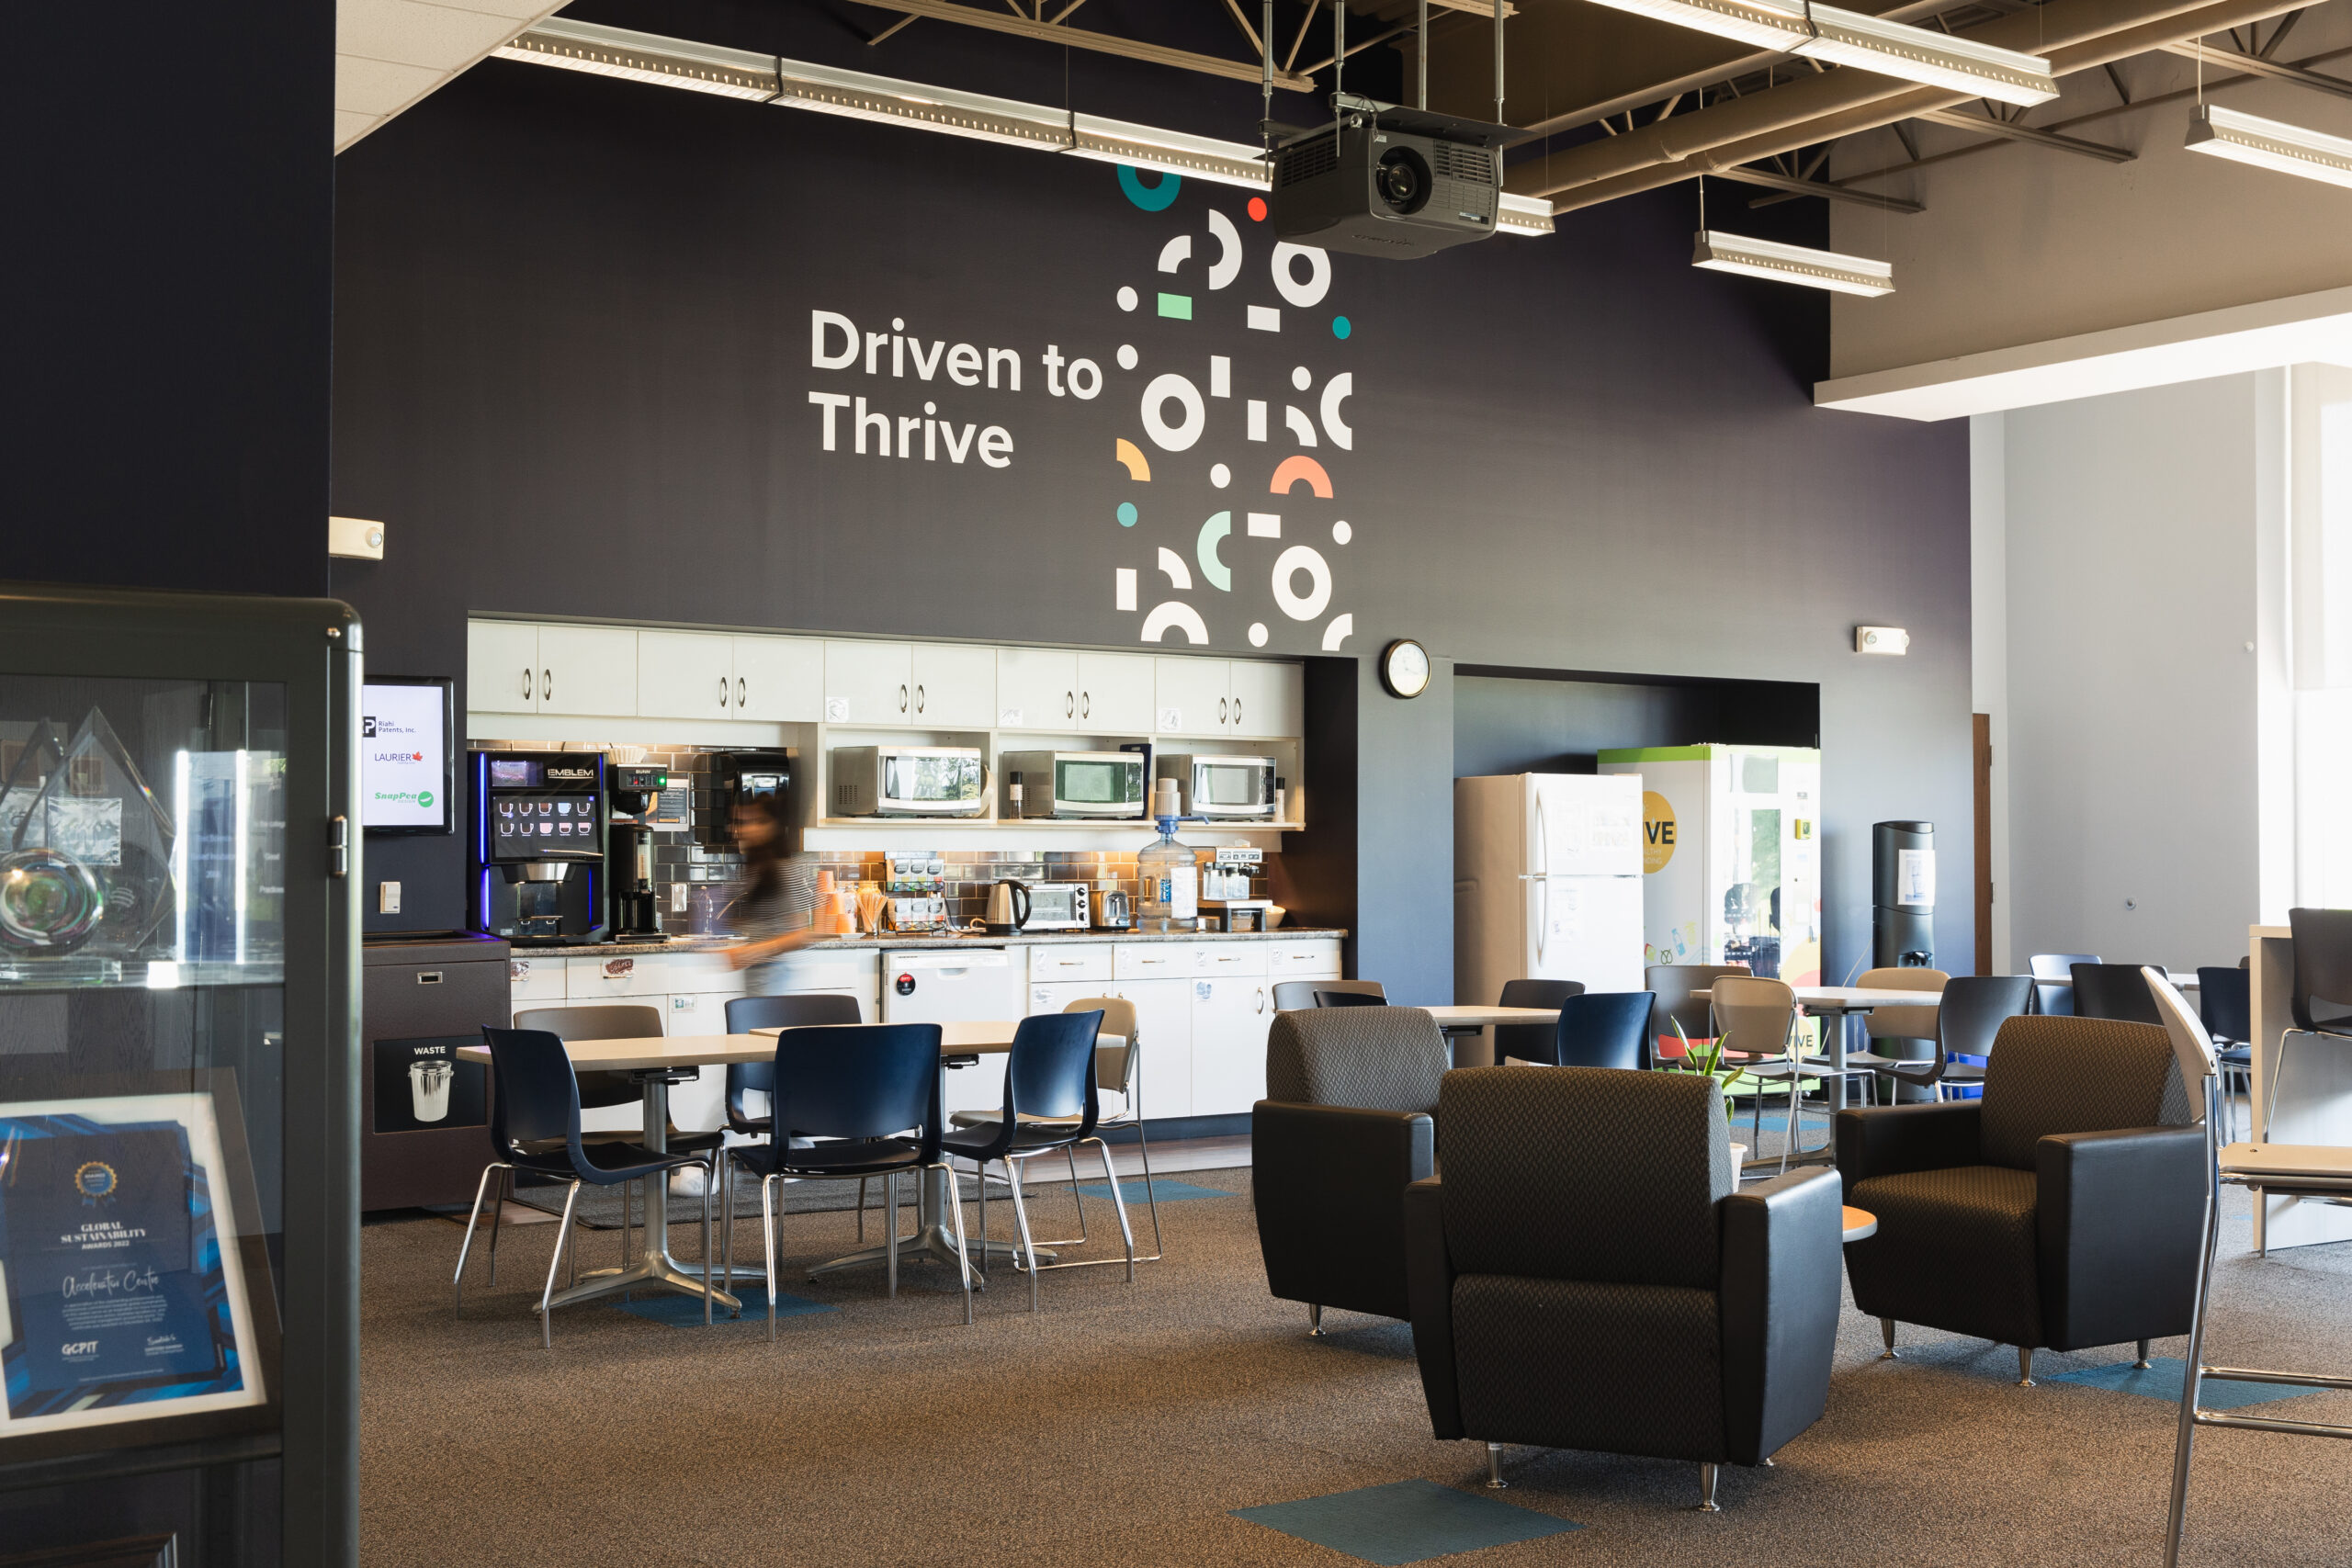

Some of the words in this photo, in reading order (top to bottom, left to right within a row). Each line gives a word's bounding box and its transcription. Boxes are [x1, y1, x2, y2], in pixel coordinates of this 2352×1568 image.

[811, 309, 1021, 392] Driven
[1042, 344, 1102, 400] to
[808, 390, 1014, 468] Thrive
[374, 752, 412, 761] LAURIER
[375, 792, 417, 801] SnapPea
[1645, 821, 1674, 844] VE
[413, 1046, 446, 1055] WASTE
[80, 1221, 123, 1232] GLOBAL
[61, 1228, 146, 1243] SUSTAINABILITY
[81, 1241, 112, 1249] AWARDS
